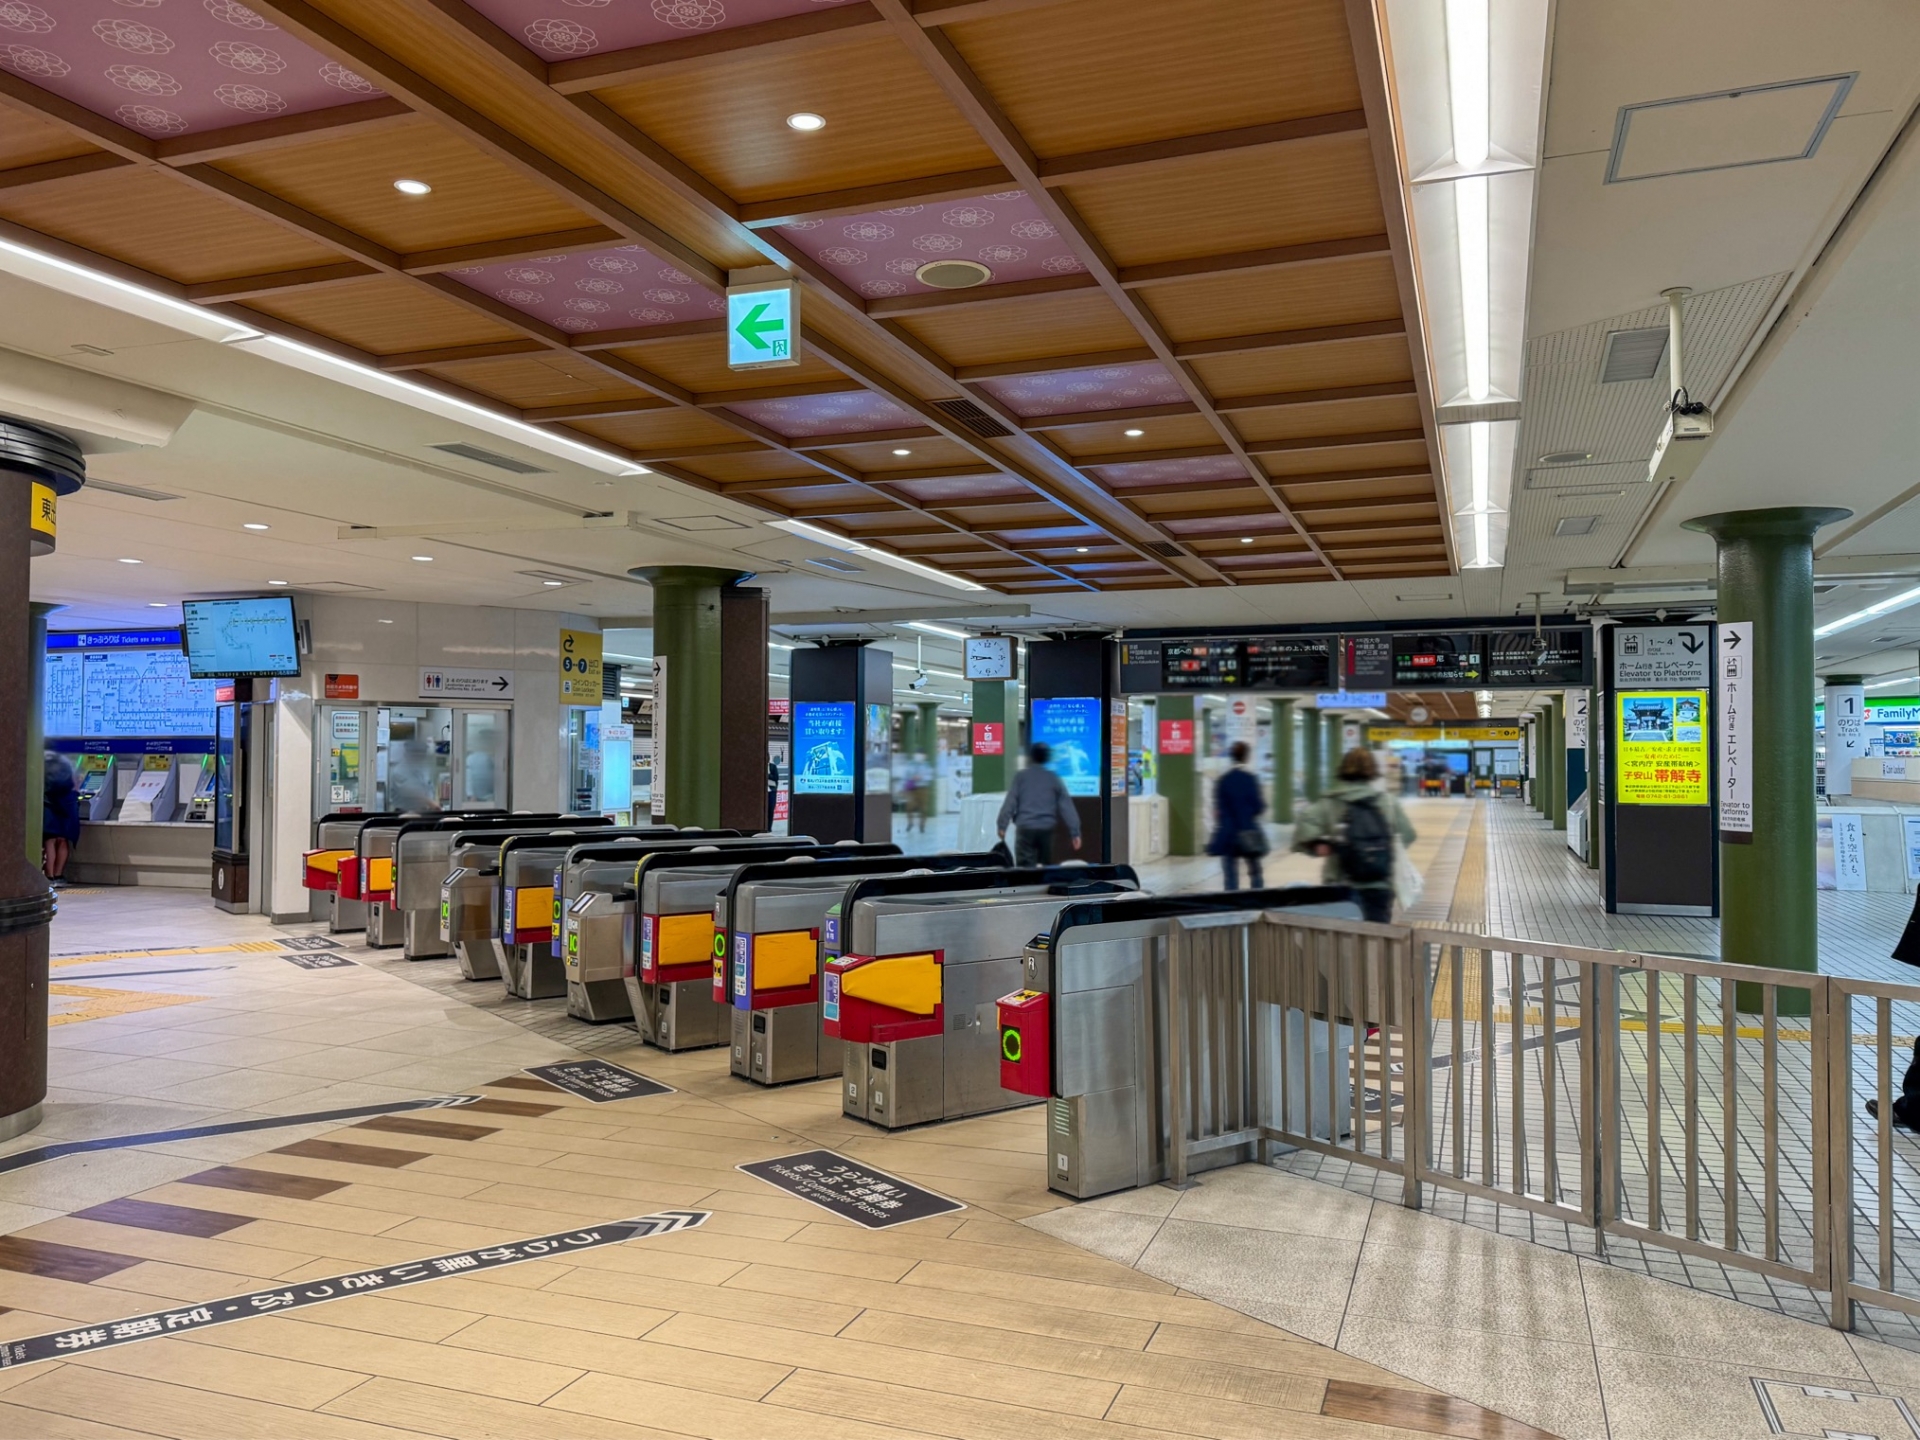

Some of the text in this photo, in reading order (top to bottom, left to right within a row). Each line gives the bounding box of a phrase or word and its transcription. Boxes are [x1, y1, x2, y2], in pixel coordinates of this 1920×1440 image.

[87, 634, 120, 645] きっぷうりば
[1167, 647, 1192, 655] 京都への
[588, 659, 599, 668] 出口
[1619, 660, 1702, 670] ホーム行き エレベーター
[1619, 669, 1651, 677] Elevator
[1663, 669, 1702, 677] Platforms
[573, 678, 600, 688] コインロッカー
[1577, 698, 1587, 715] 2
[1844, 697, 1854, 714] 1
[1837, 718, 1861, 727] のりば
[1841, 726, 1859, 734] Track
[1727, 682, 1737, 799] ホーム行き エレベーター
[1623, 768, 1702, 784] 子安山 帯解寺
[1742, 800, 1750, 809] to
[1846, 822, 1860, 877] 食も空気も、
[825, 919, 835, 933] IC
[792, 1163, 904, 1211] きっぷ・定期券
[826, 1164, 908, 1199] うらが黒い
[854, 1200, 891, 1220] Passes
